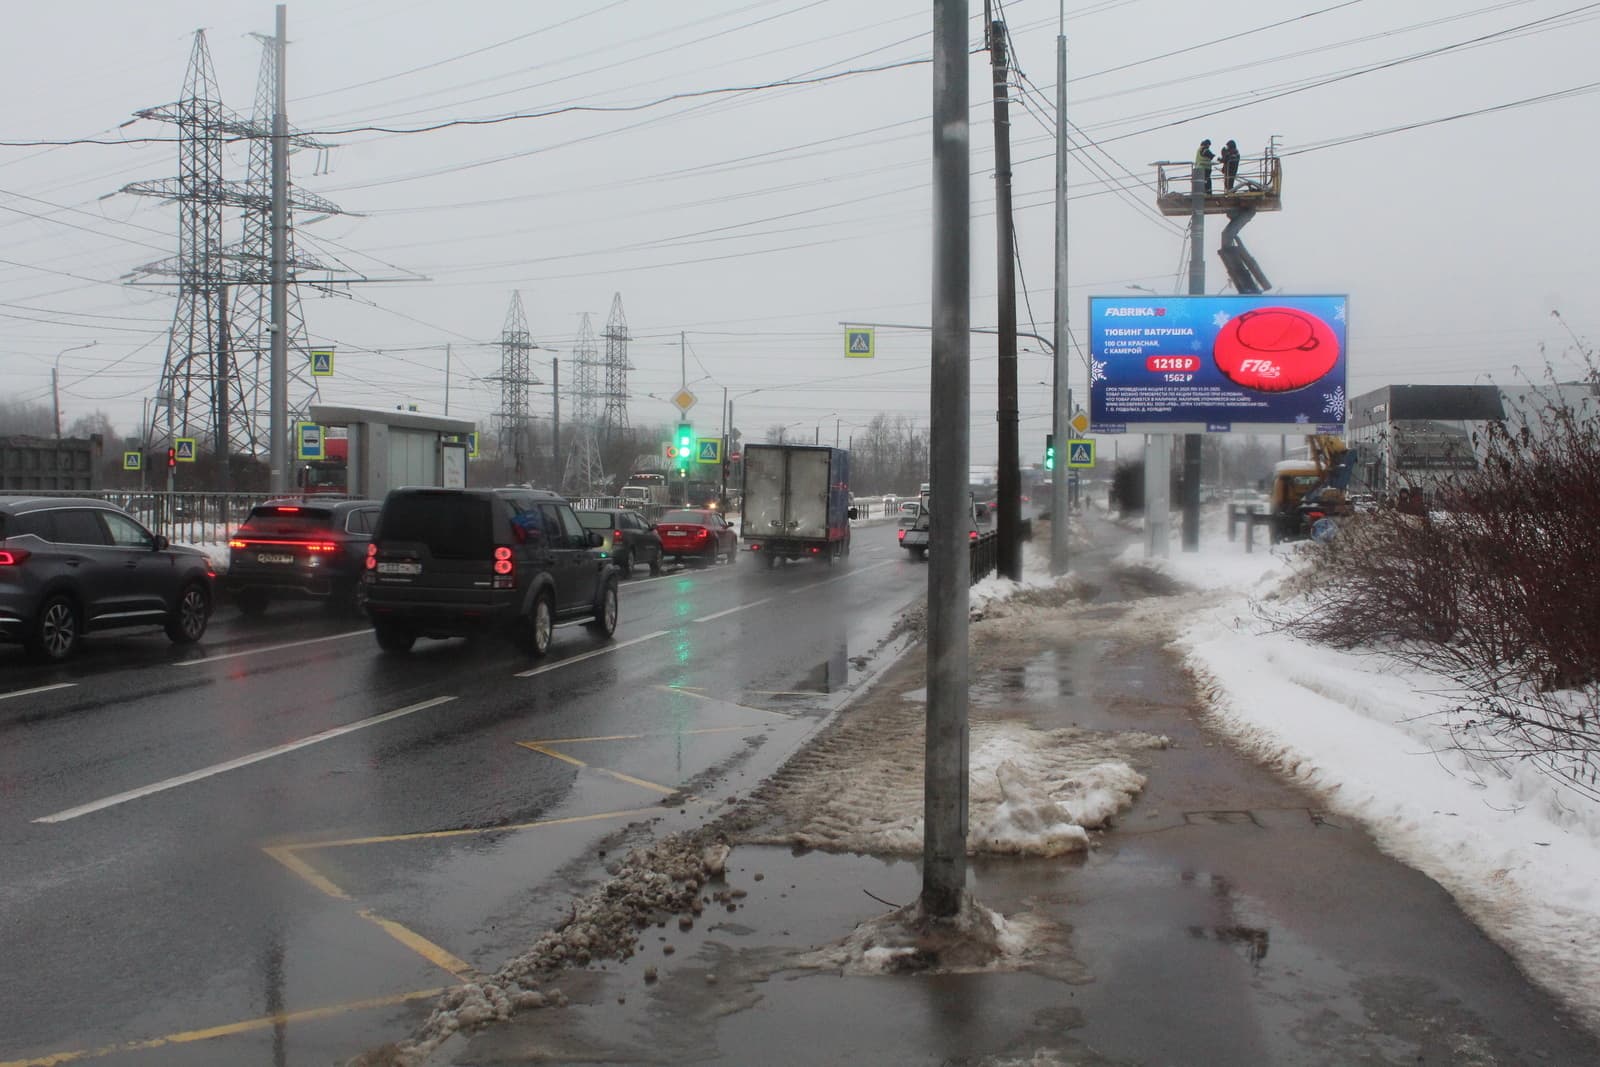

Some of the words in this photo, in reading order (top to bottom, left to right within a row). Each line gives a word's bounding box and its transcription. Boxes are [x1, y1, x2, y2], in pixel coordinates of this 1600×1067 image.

[1104, 328, 1142, 336] ТЮБИНГ
[1144, 328, 1193, 336] ВАТРУШКА
[1153, 358, 1183, 369] 1218
[1184, 358, 1193, 369] ₽
[1164, 374, 1185, 382] 1562
